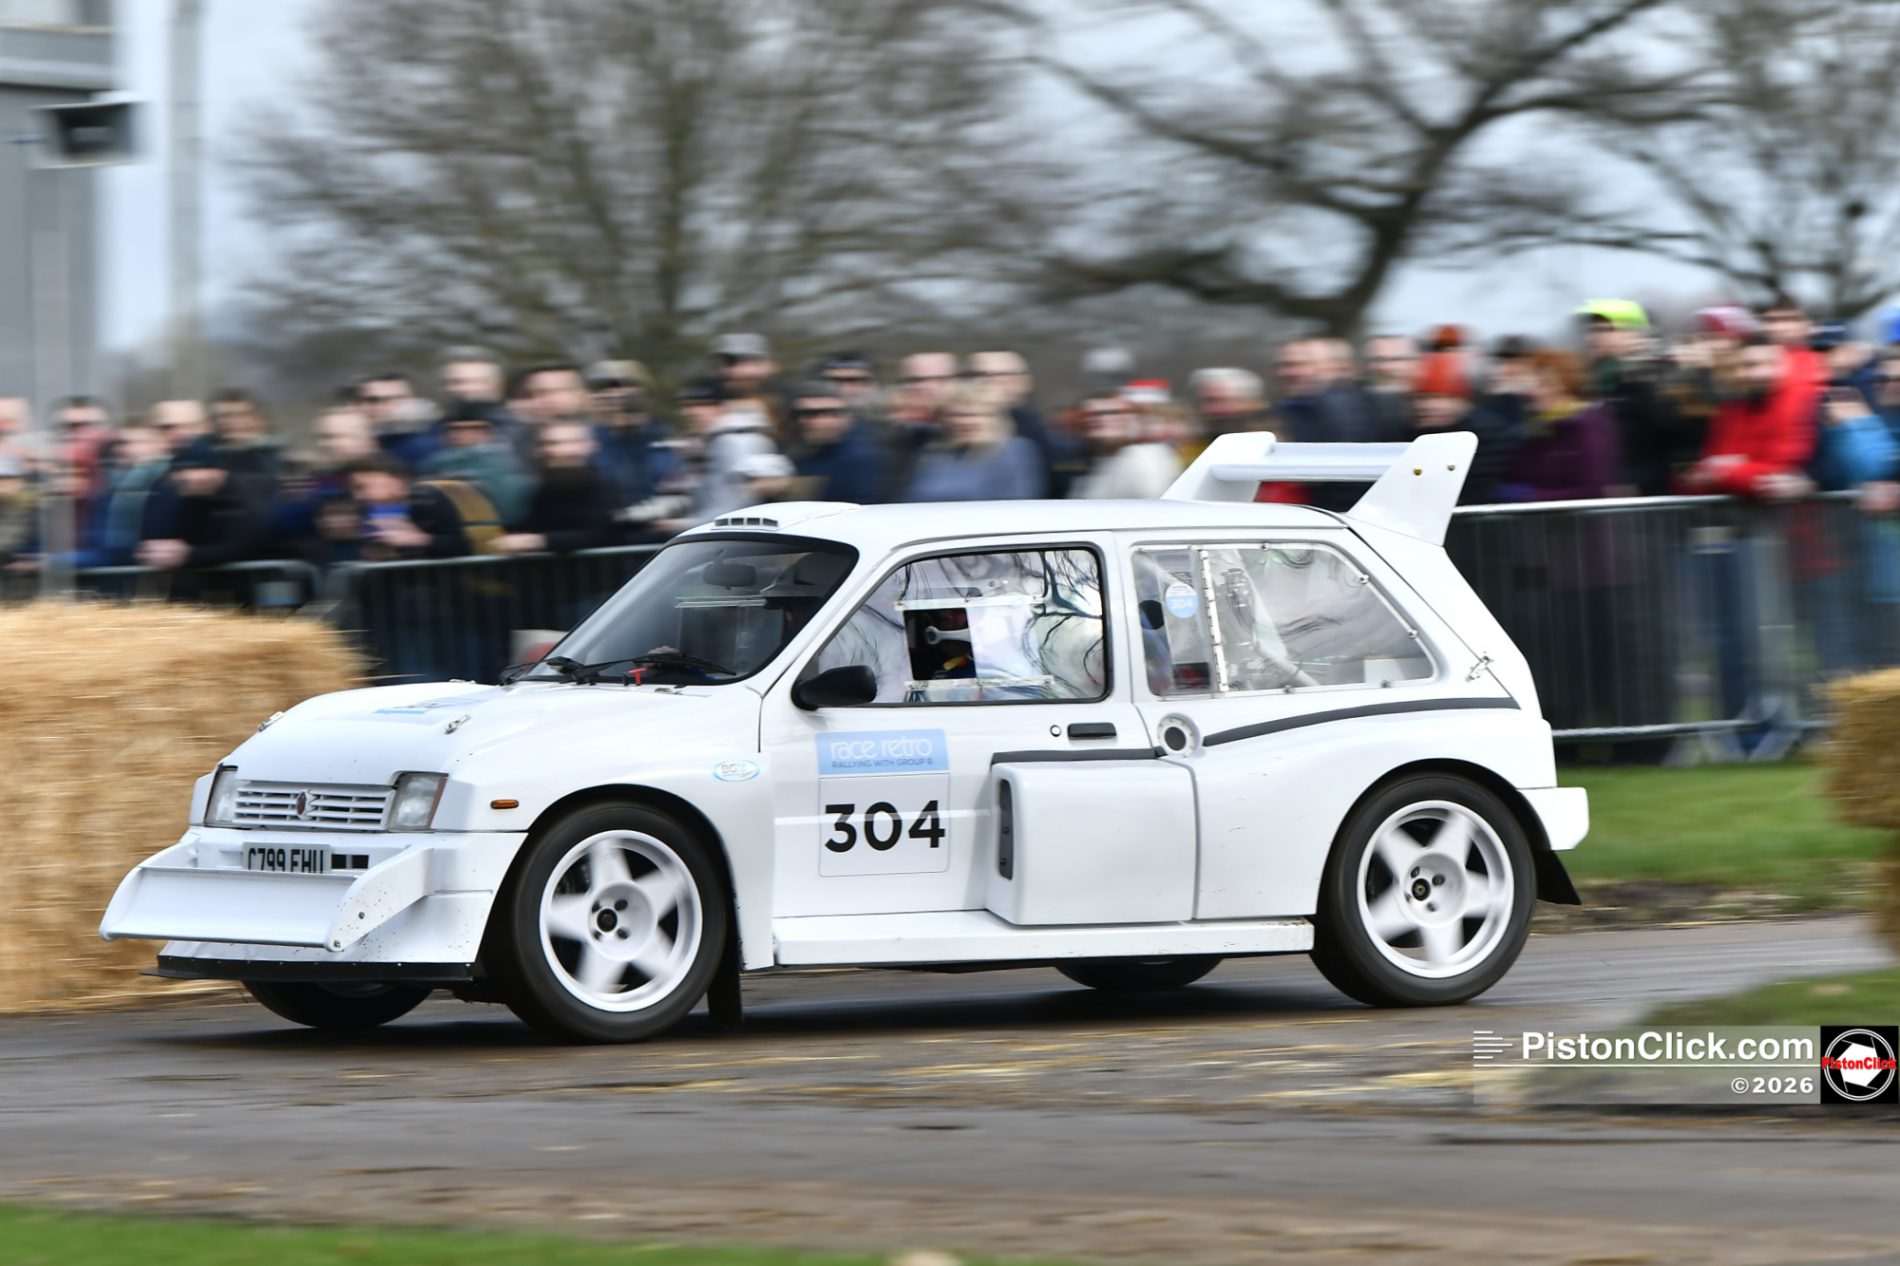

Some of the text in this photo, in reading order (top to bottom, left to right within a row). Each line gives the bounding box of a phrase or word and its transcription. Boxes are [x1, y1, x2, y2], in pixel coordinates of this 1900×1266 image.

[830, 736, 933, 759] race retro
[831, 759, 872, 768] RALLYING
[873, 759, 895, 767] WITH
[896, 758, 925, 766] GROUP
[824, 800, 946, 853] 304
